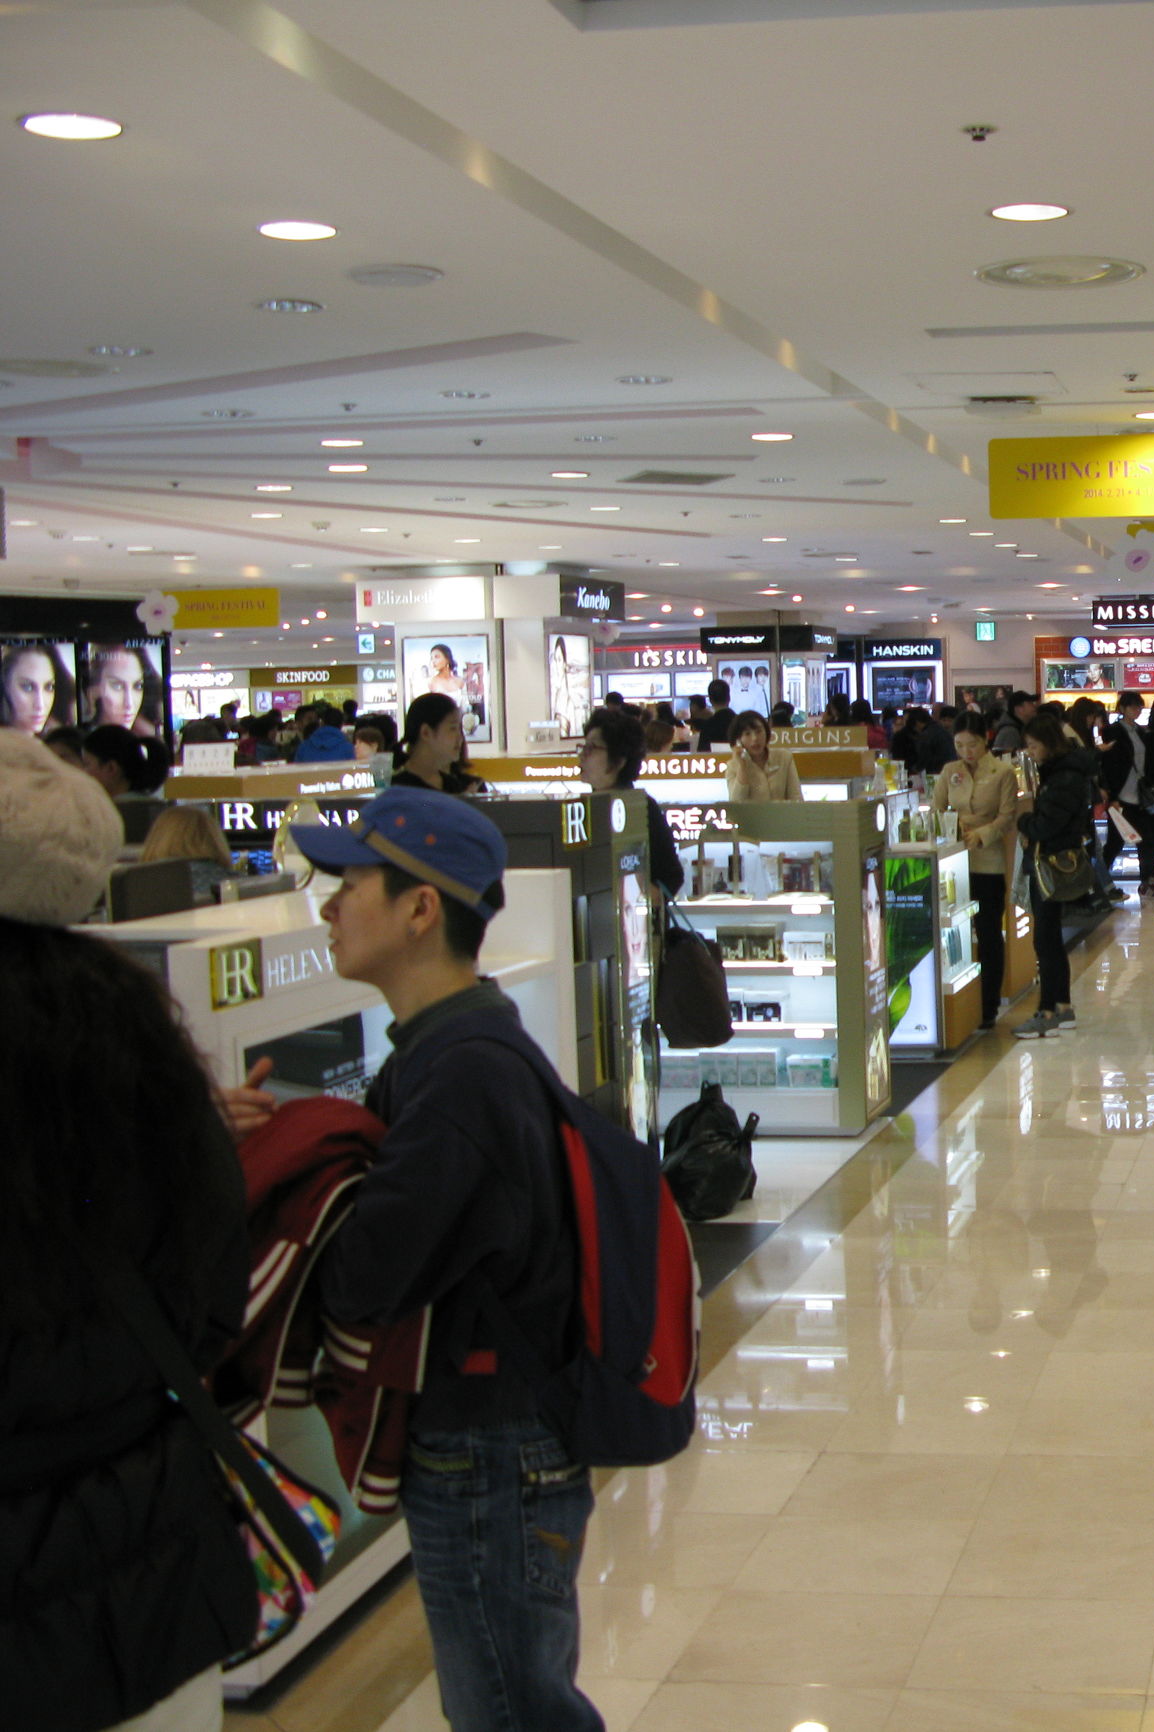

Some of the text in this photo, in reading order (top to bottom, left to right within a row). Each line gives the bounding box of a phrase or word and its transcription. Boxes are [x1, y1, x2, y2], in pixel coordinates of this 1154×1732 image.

[1016, 460, 1101, 483] SPRING
[576, 586, 611, 611] Kanebo
[873, 645, 934, 658] HANSKIN
[276, 670, 331, 684] SKINFOOD
[221, 802, 258, 831] HR
[566, 801, 588, 844] HR
[220, 948, 259, 1002] HR
